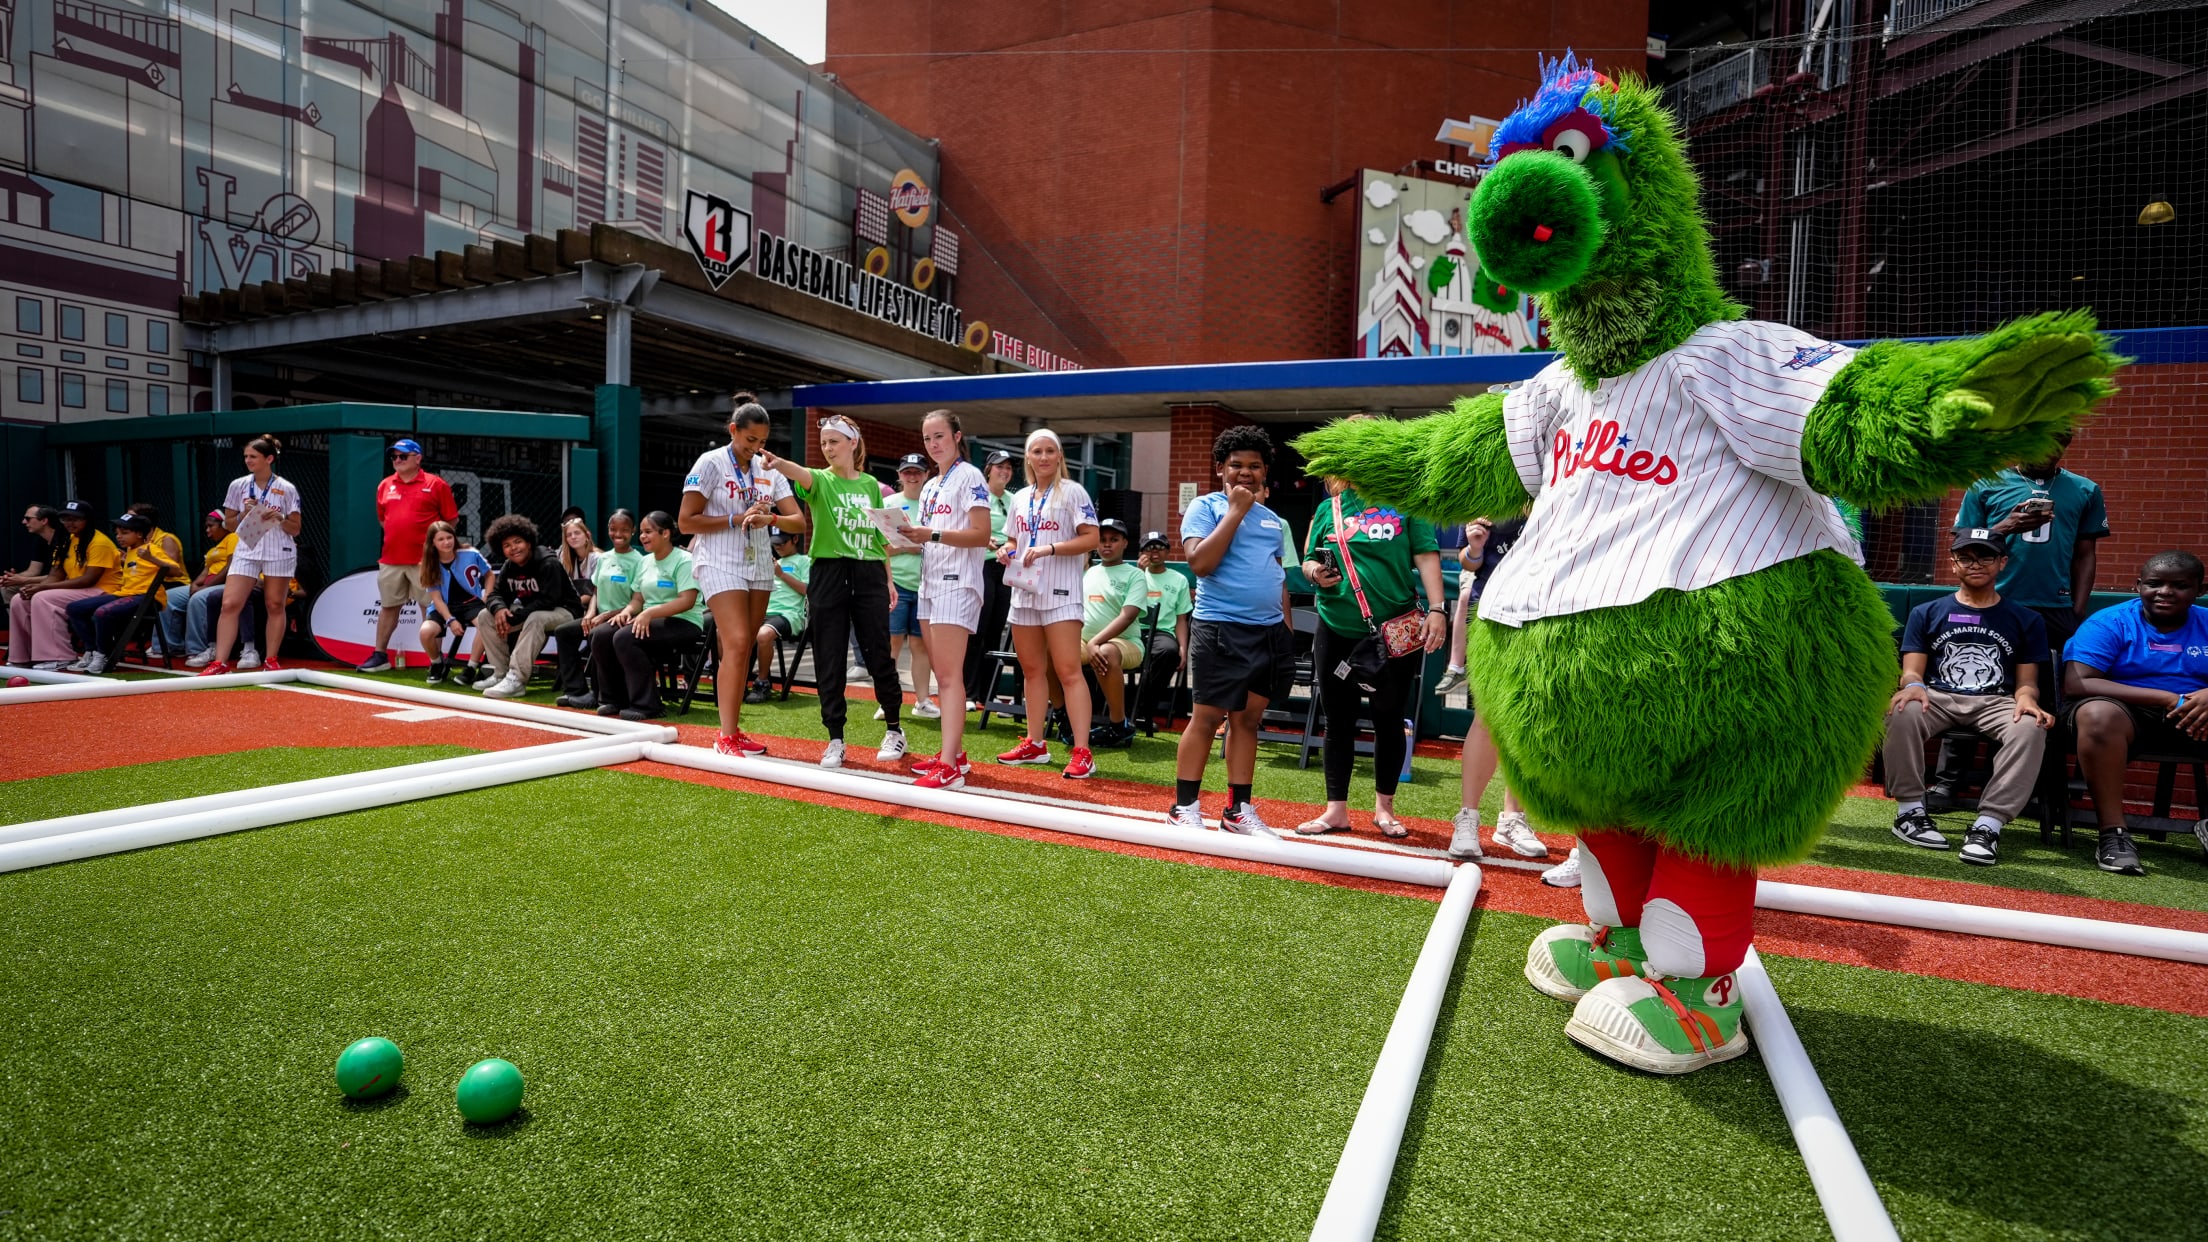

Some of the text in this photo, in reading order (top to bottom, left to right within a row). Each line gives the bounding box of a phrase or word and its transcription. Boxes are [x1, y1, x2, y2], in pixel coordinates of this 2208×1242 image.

[890, 187, 931, 210] Hatfield
[756, 229, 962, 347] BASEBALL LIFESTYLE 101
[993, 330, 1023, 361] THE
[1550, 419, 1679, 488] Phillies
[464, 564, 480, 589] P
[363, 608, 417, 617] Olyics
[1988, 630, 2014, 656] SCHOOL
[1711, 975, 1733, 1006] P
